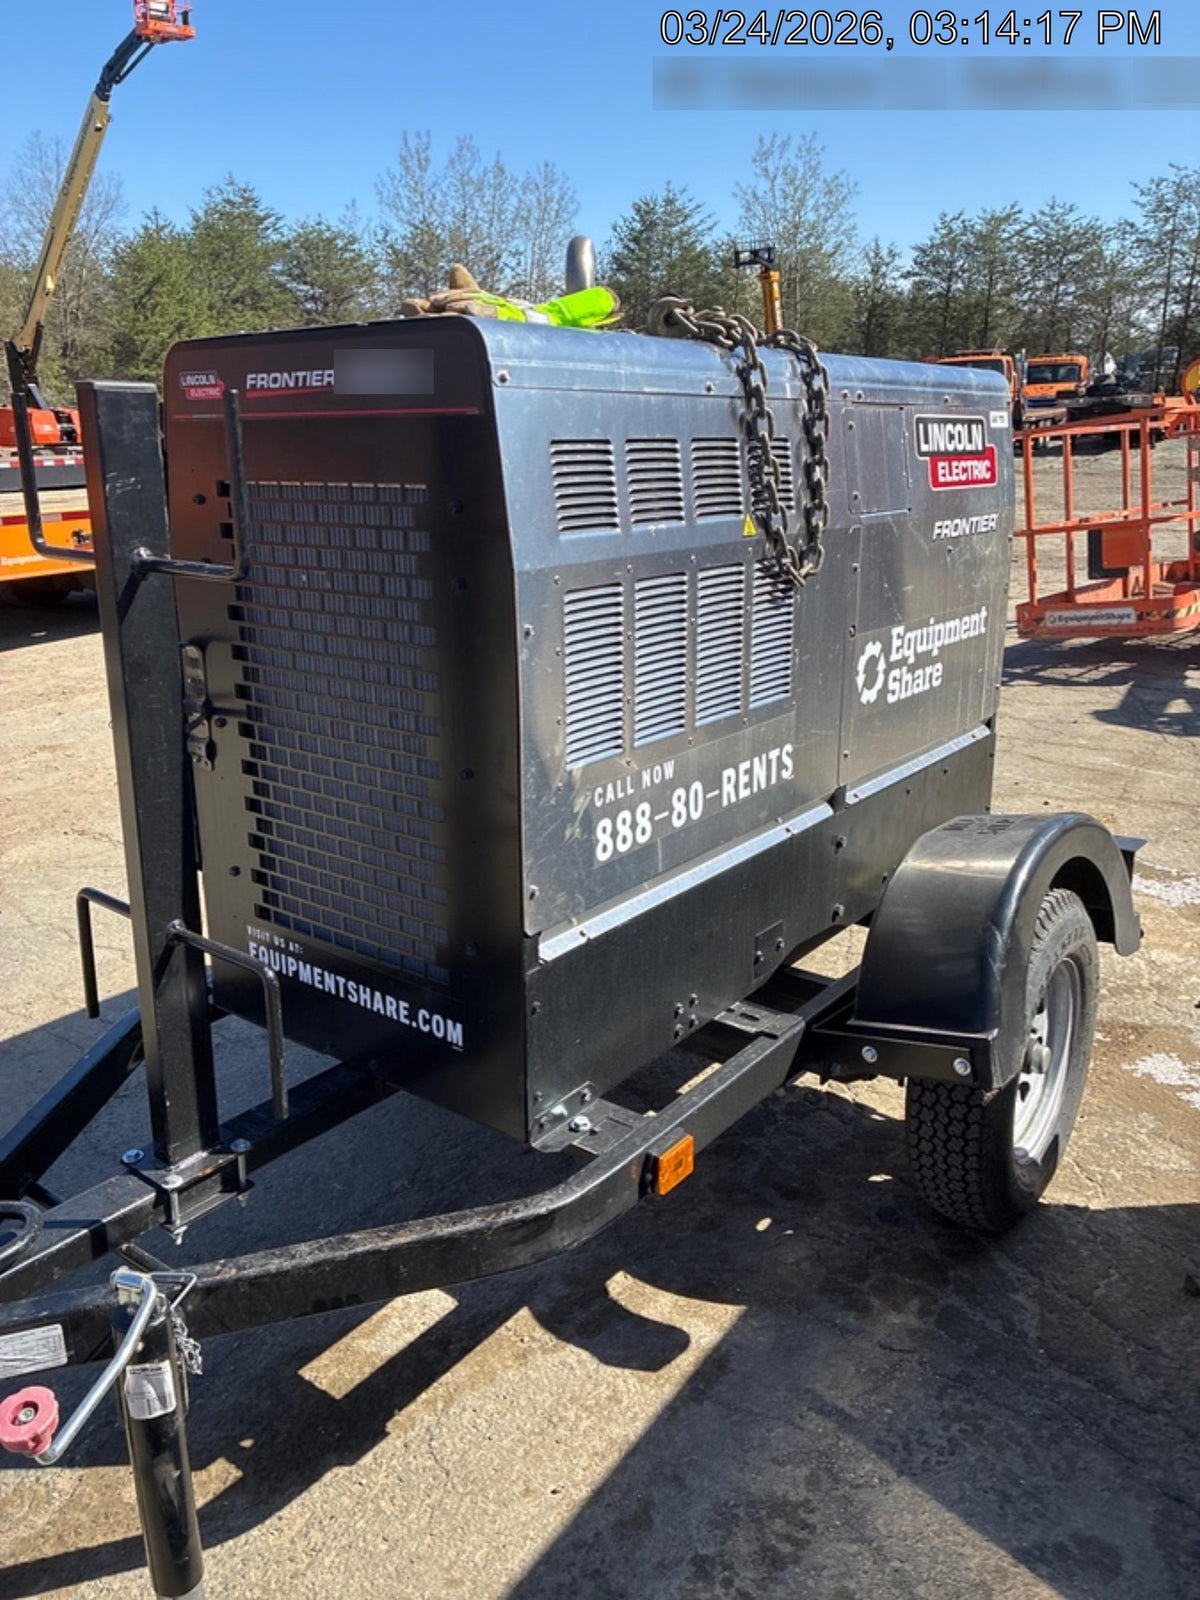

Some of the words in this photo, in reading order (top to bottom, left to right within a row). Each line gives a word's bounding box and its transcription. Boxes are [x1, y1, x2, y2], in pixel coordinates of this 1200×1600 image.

[180, 374, 216, 386] LINCOLN
[246, 369, 335, 390] FRONTIER
[919, 422, 983, 452] LINCOLN
[937, 460, 991, 482] ELECTRIC
[932, 513, 999, 540] FRONTIER
[889, 606, 987, 664] Equipment
[887, 662, 943, 704] Share
[594, 776, 635, 807] CALL
[641, 759, 675, 789] NOW
[595, 743, 794, 862] 888-80-RENTS
[246, 924, 270, 942] VISIT
[273, 936, 285, 948] US
[289, 941, 304, 954] AT:
[248, 940, 464, 1047] EQUIPMENTSHARE.COM
